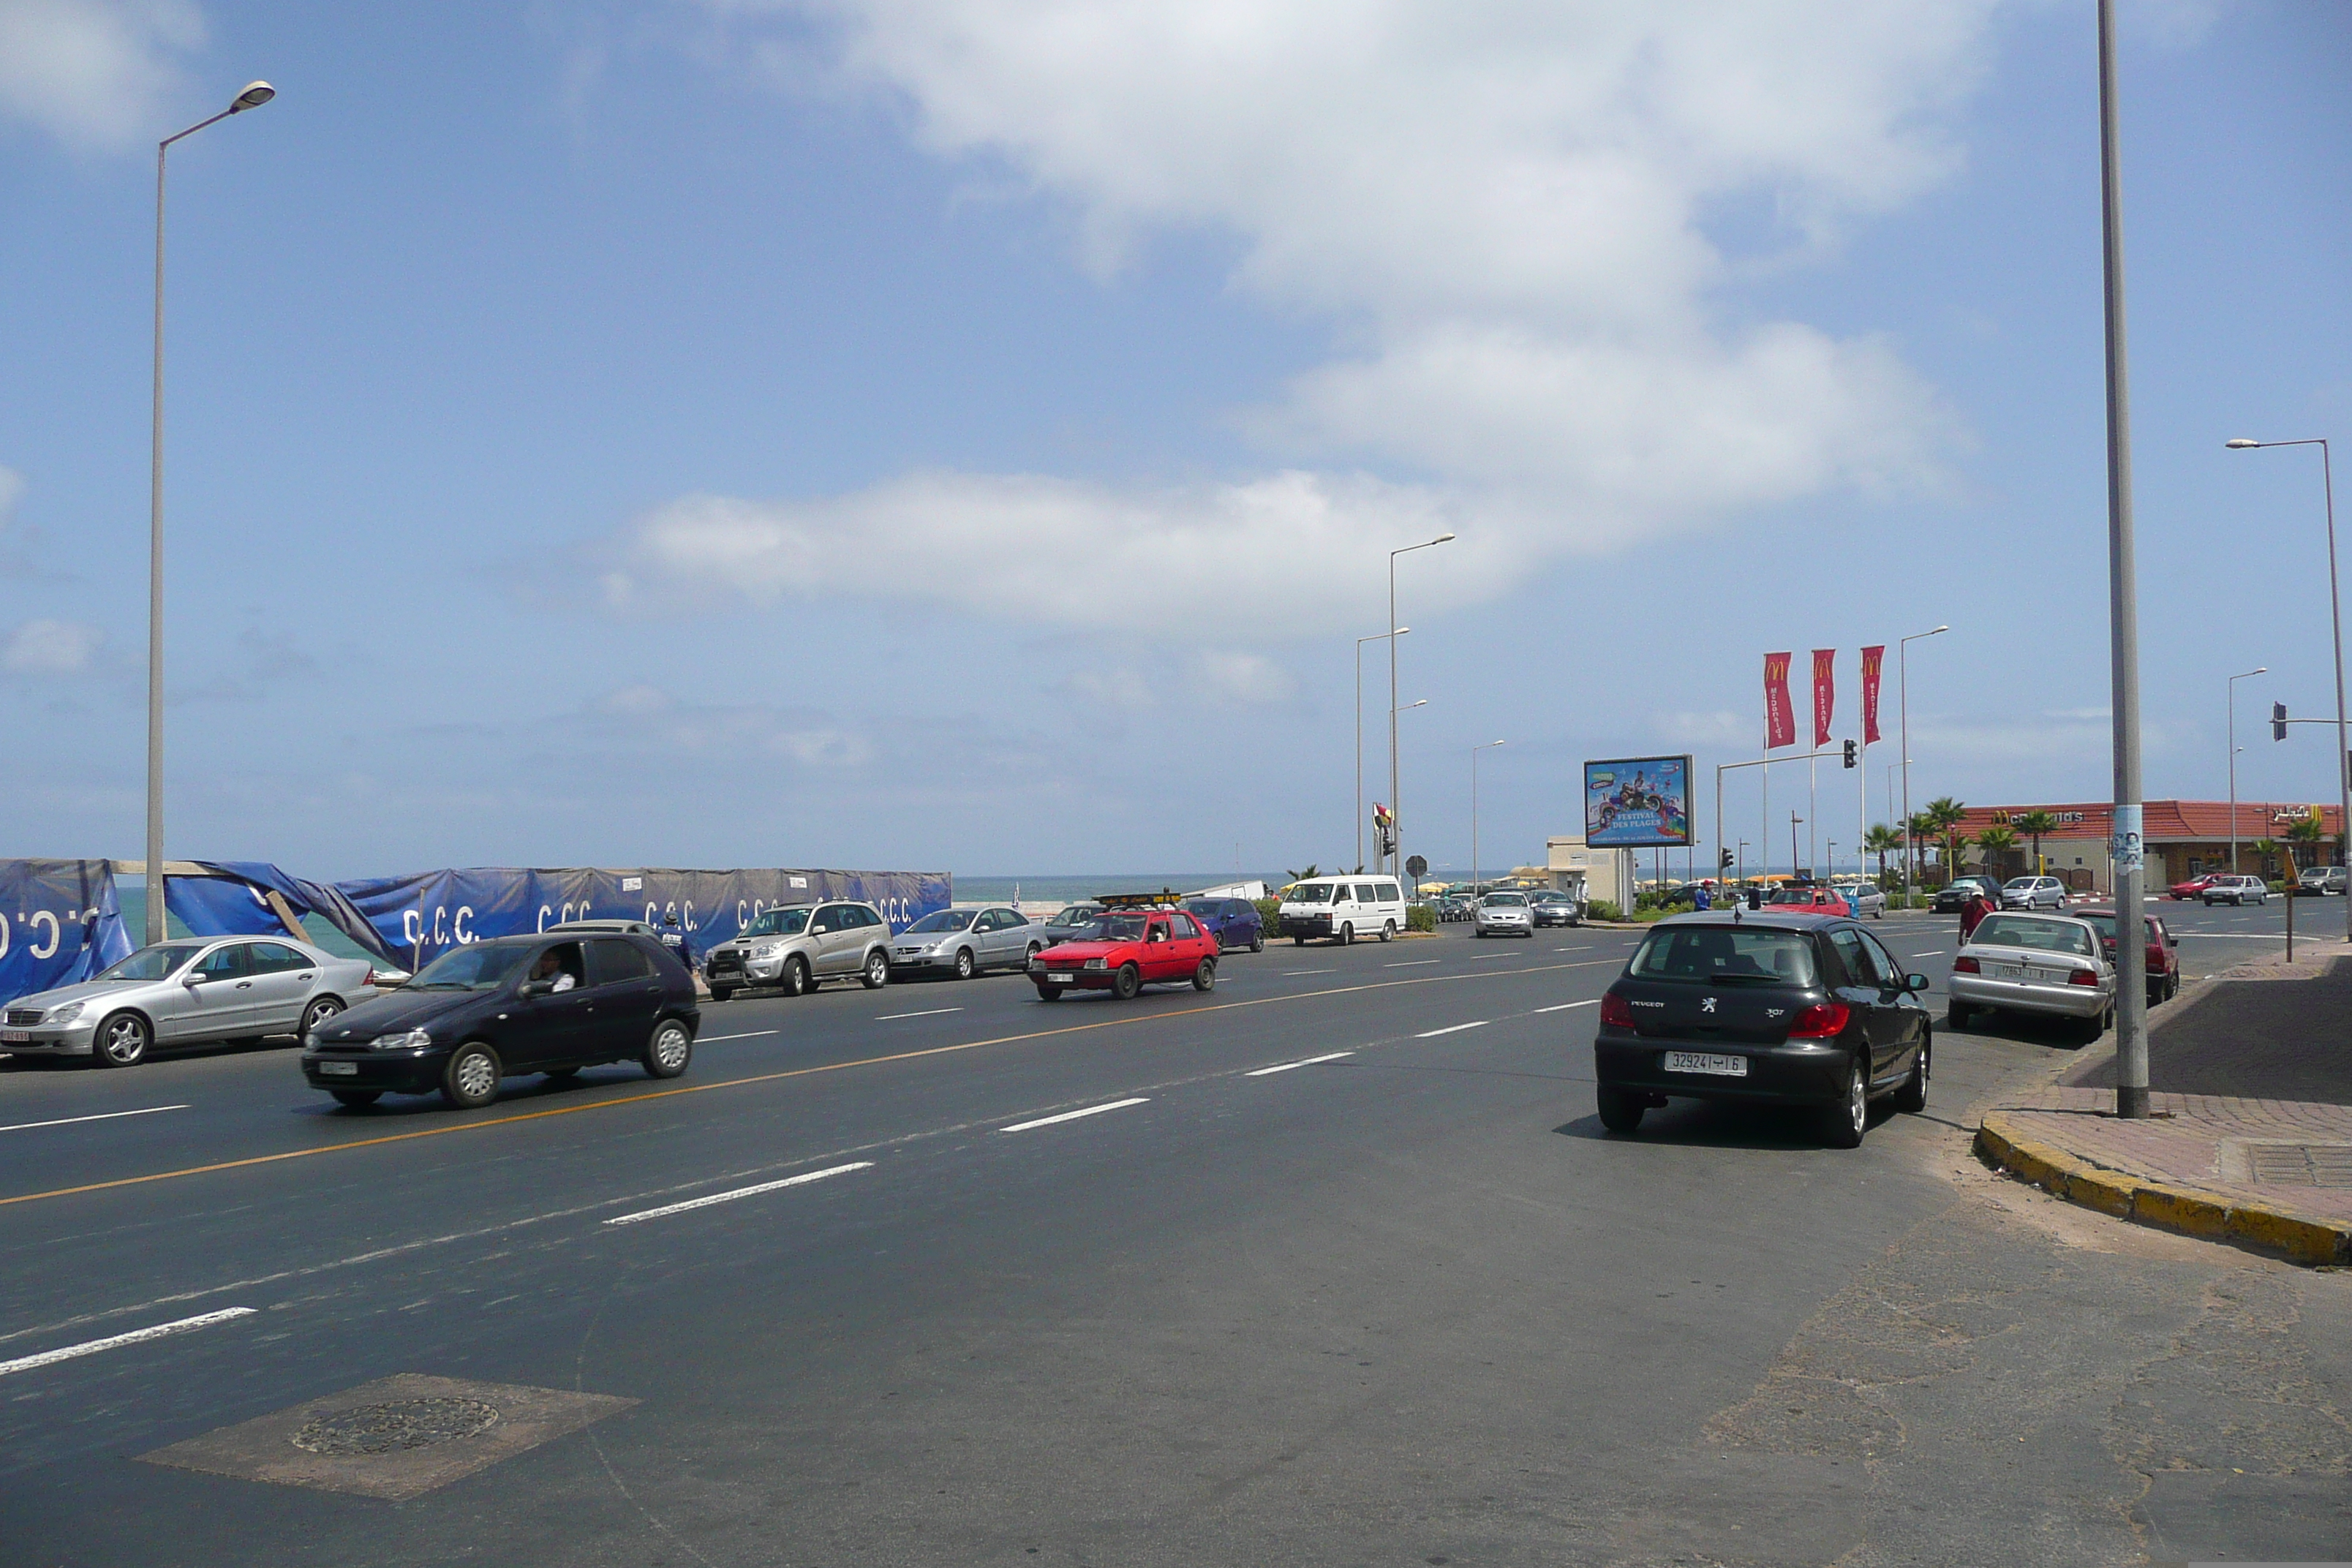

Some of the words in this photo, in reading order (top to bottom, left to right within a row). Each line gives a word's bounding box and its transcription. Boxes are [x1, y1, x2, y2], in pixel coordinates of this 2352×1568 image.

[1770, 687, 1783, 739] McDonald's
[1618, 812, 1654, 821] FESTIVAL
[1630, 819, 1661, 827] PLAGES
[1993, 810, 2084, 826] McDld's
[403, 905, 480, 945] C.C.C.
